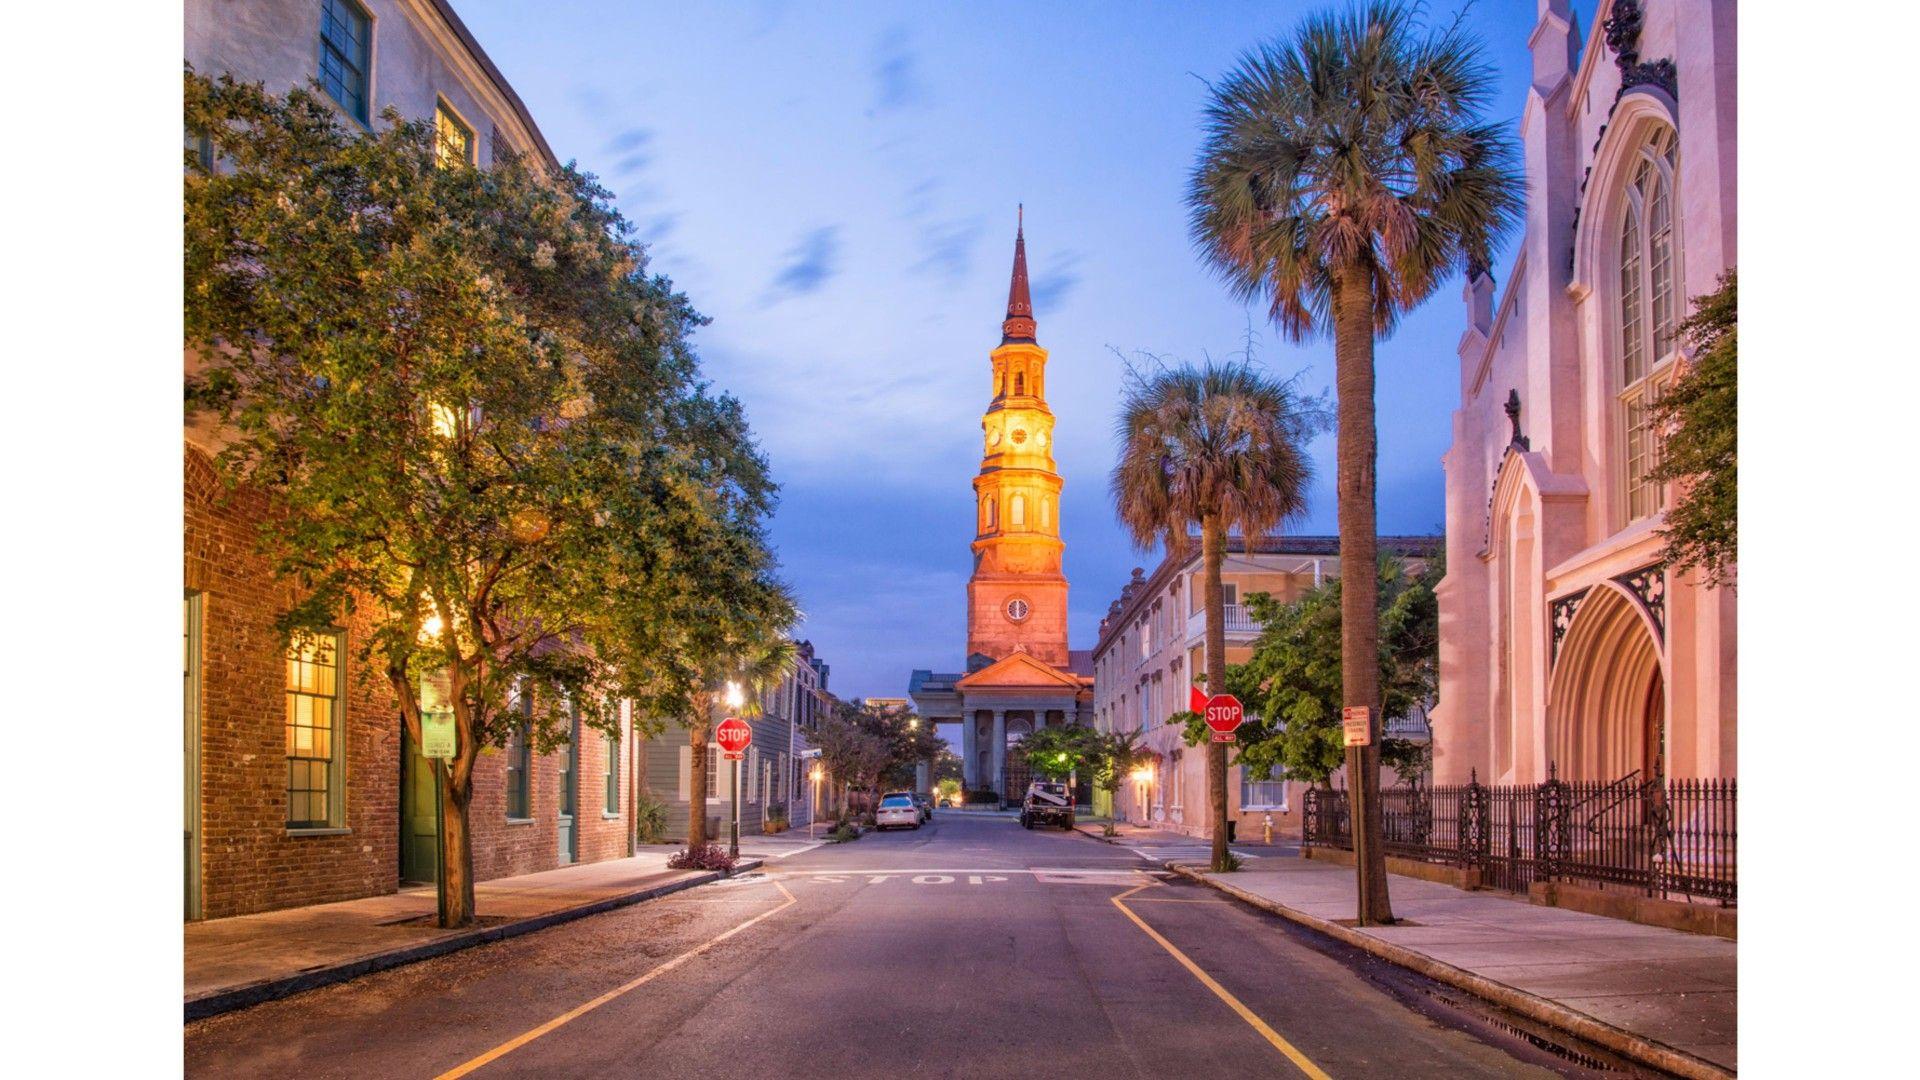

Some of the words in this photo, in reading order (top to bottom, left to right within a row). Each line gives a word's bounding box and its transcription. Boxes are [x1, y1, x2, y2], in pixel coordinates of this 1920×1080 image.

[1207, 706, 1240, 721] STOP
[719, 728, 750, 742] STOP
[807, 875, 1009, 885] STOP
